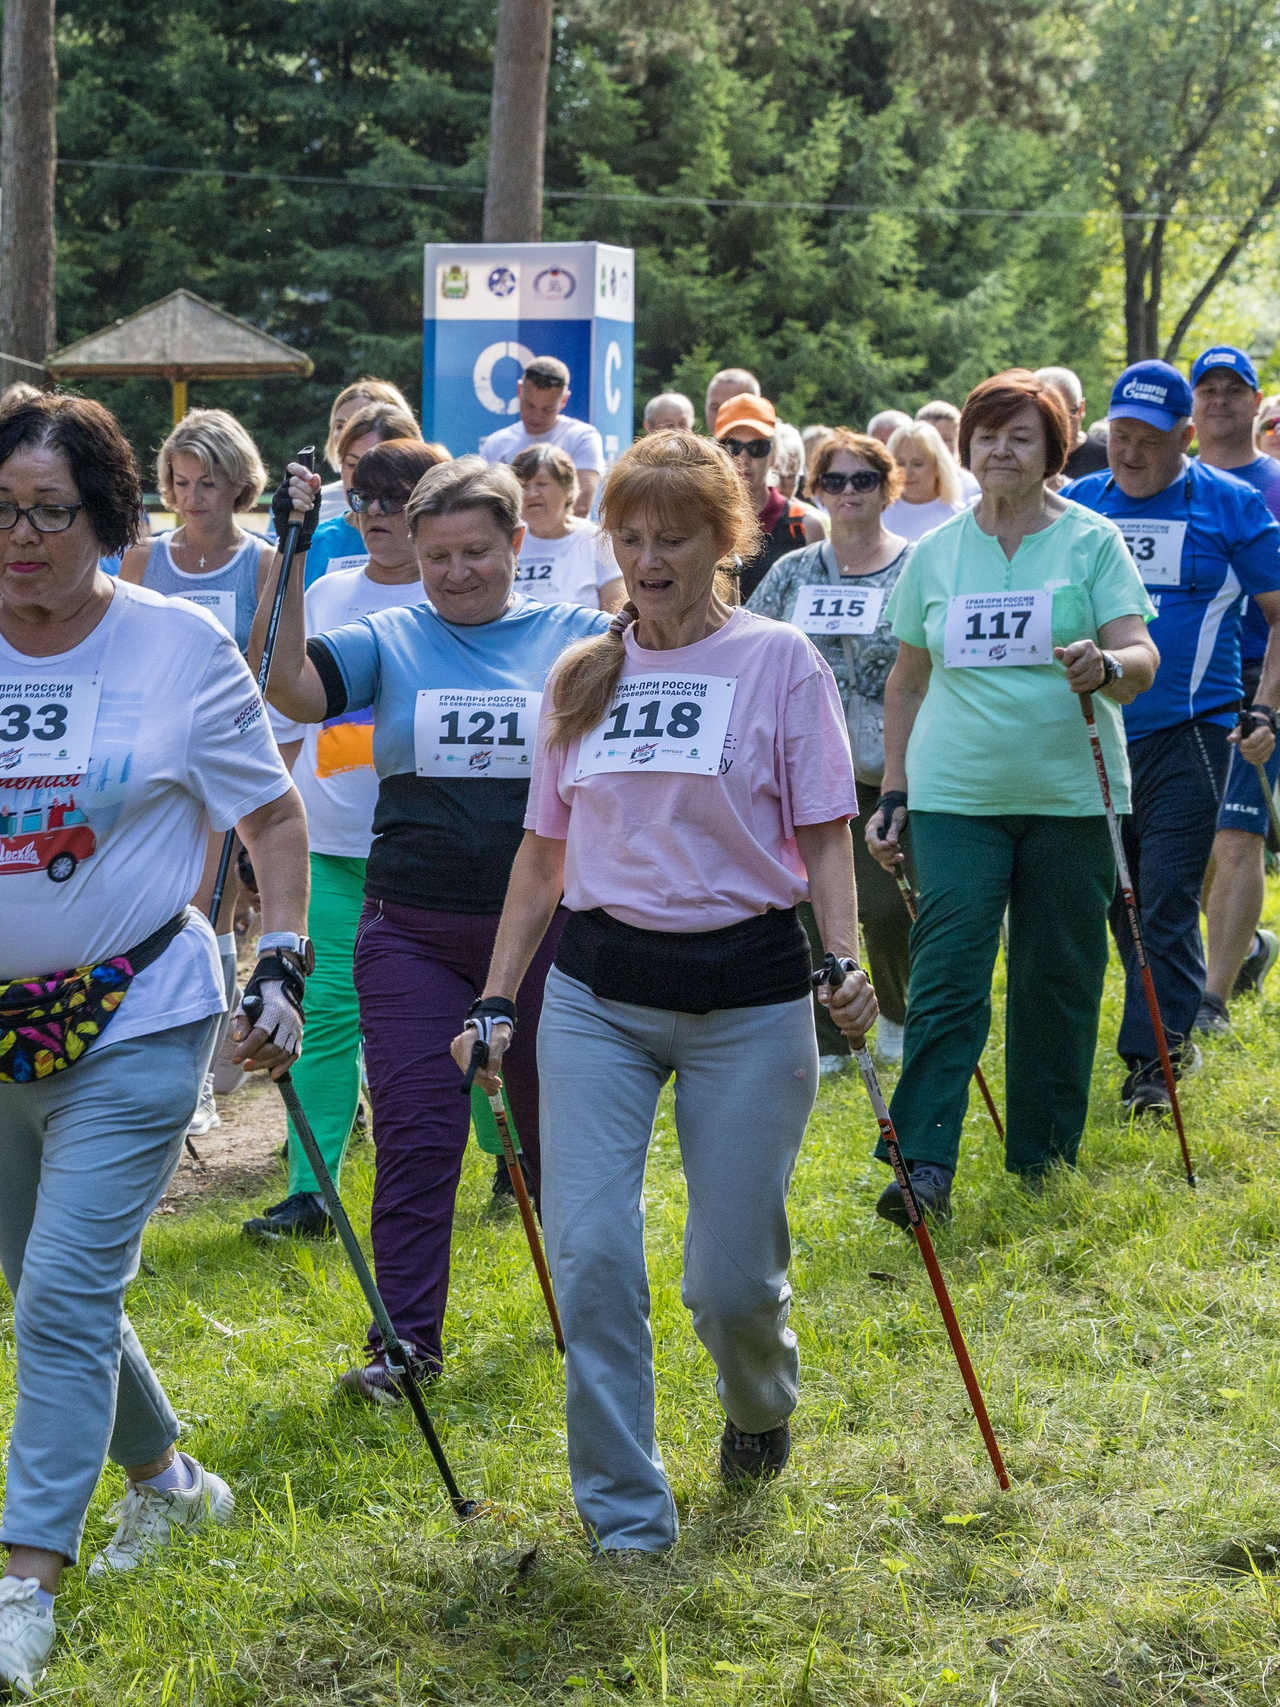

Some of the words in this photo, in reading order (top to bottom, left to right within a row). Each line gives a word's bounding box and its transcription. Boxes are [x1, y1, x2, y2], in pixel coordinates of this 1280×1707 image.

[809, 599, 866, 617] 115
[966, 597, 1002, 606] ГРАН-ПРИ
[1003, 596, 1034, 604] РОССИИ
[965, 611, 1032, 640] 117
[24, 683, 73, 692] РОССИИ
[662, 681, 707, 691] РОССИИ
[440, 695, 485, 703] ГРАН-ПРИ
[621, 689, 659, 698] северной
[661, 689, 691, 697] ходьбе
[603, 700, 702, 741] 118
[439, 710, 525, 746] 121
[885, 1144, 908, 1187] WALKER
[900, 1186, 920, 1223] SERIES
